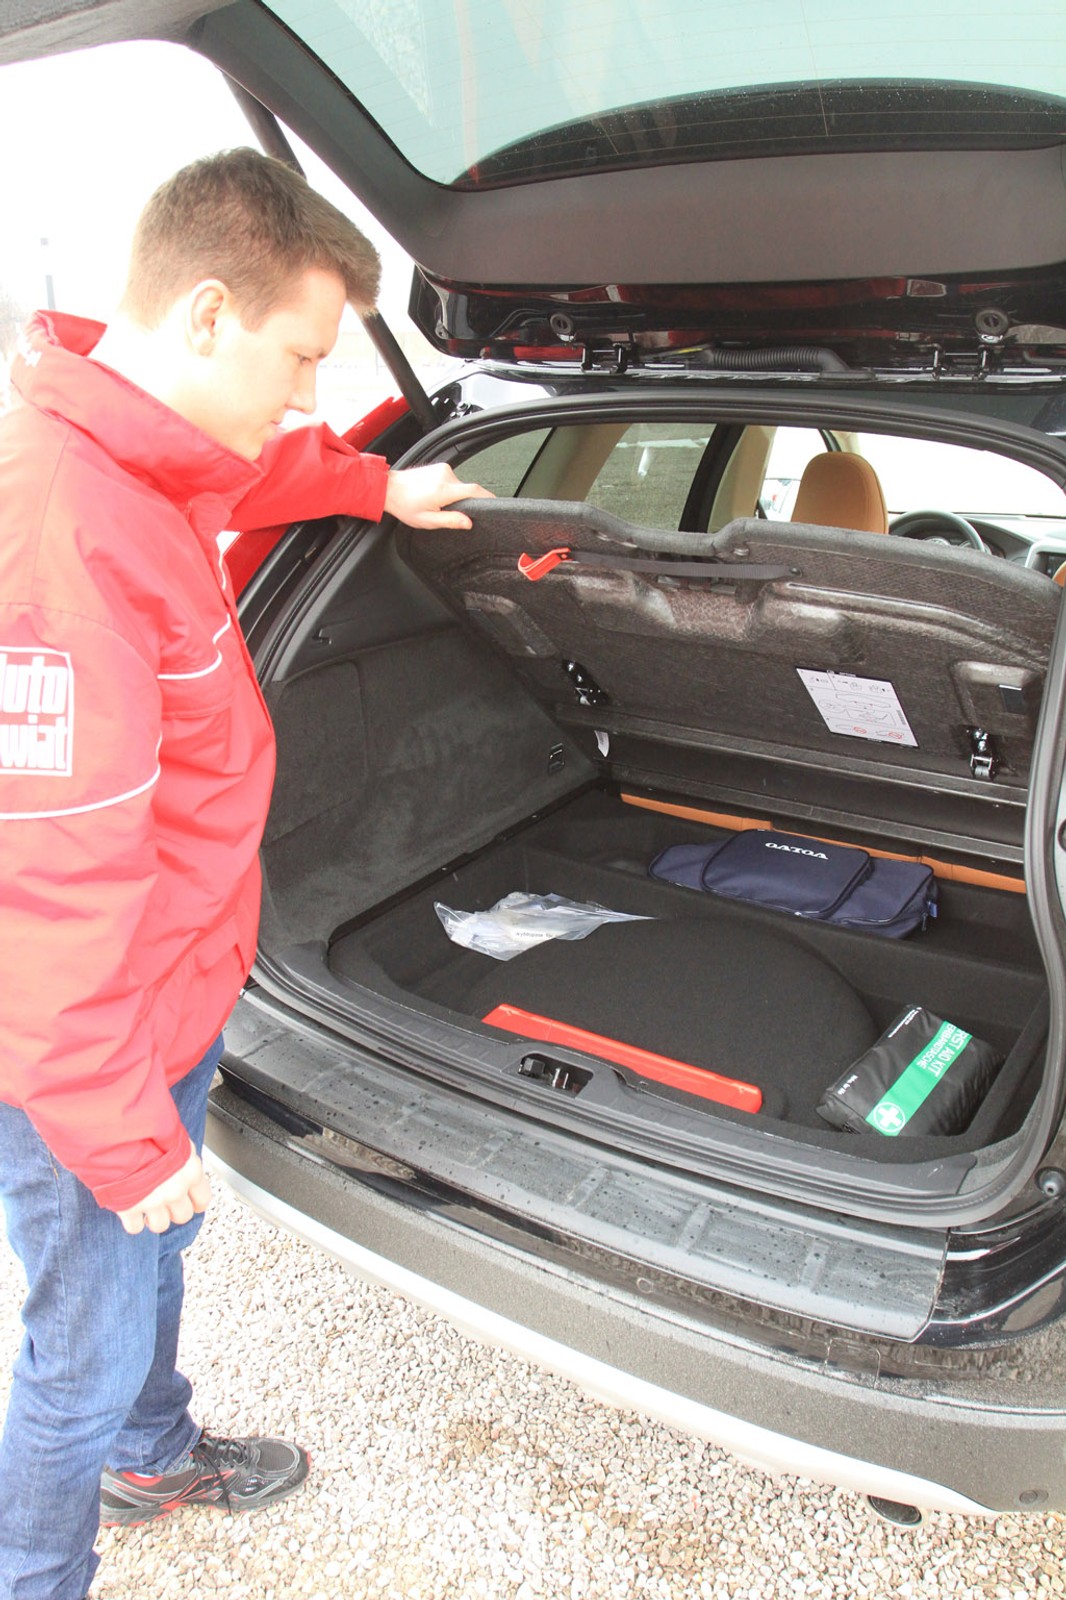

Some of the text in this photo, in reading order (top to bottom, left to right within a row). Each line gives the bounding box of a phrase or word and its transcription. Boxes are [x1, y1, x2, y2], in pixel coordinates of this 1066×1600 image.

[0, 653, 67, 714] uto
[0, 714, 67, 770] wiat
[765, 842, 829, 860] VOLVO
[916, 1023, 957, 1069] ERBANDTASCHE
[938, 1046, 956, 1062] AID
[928, 1060, 946, 1078] KIT
